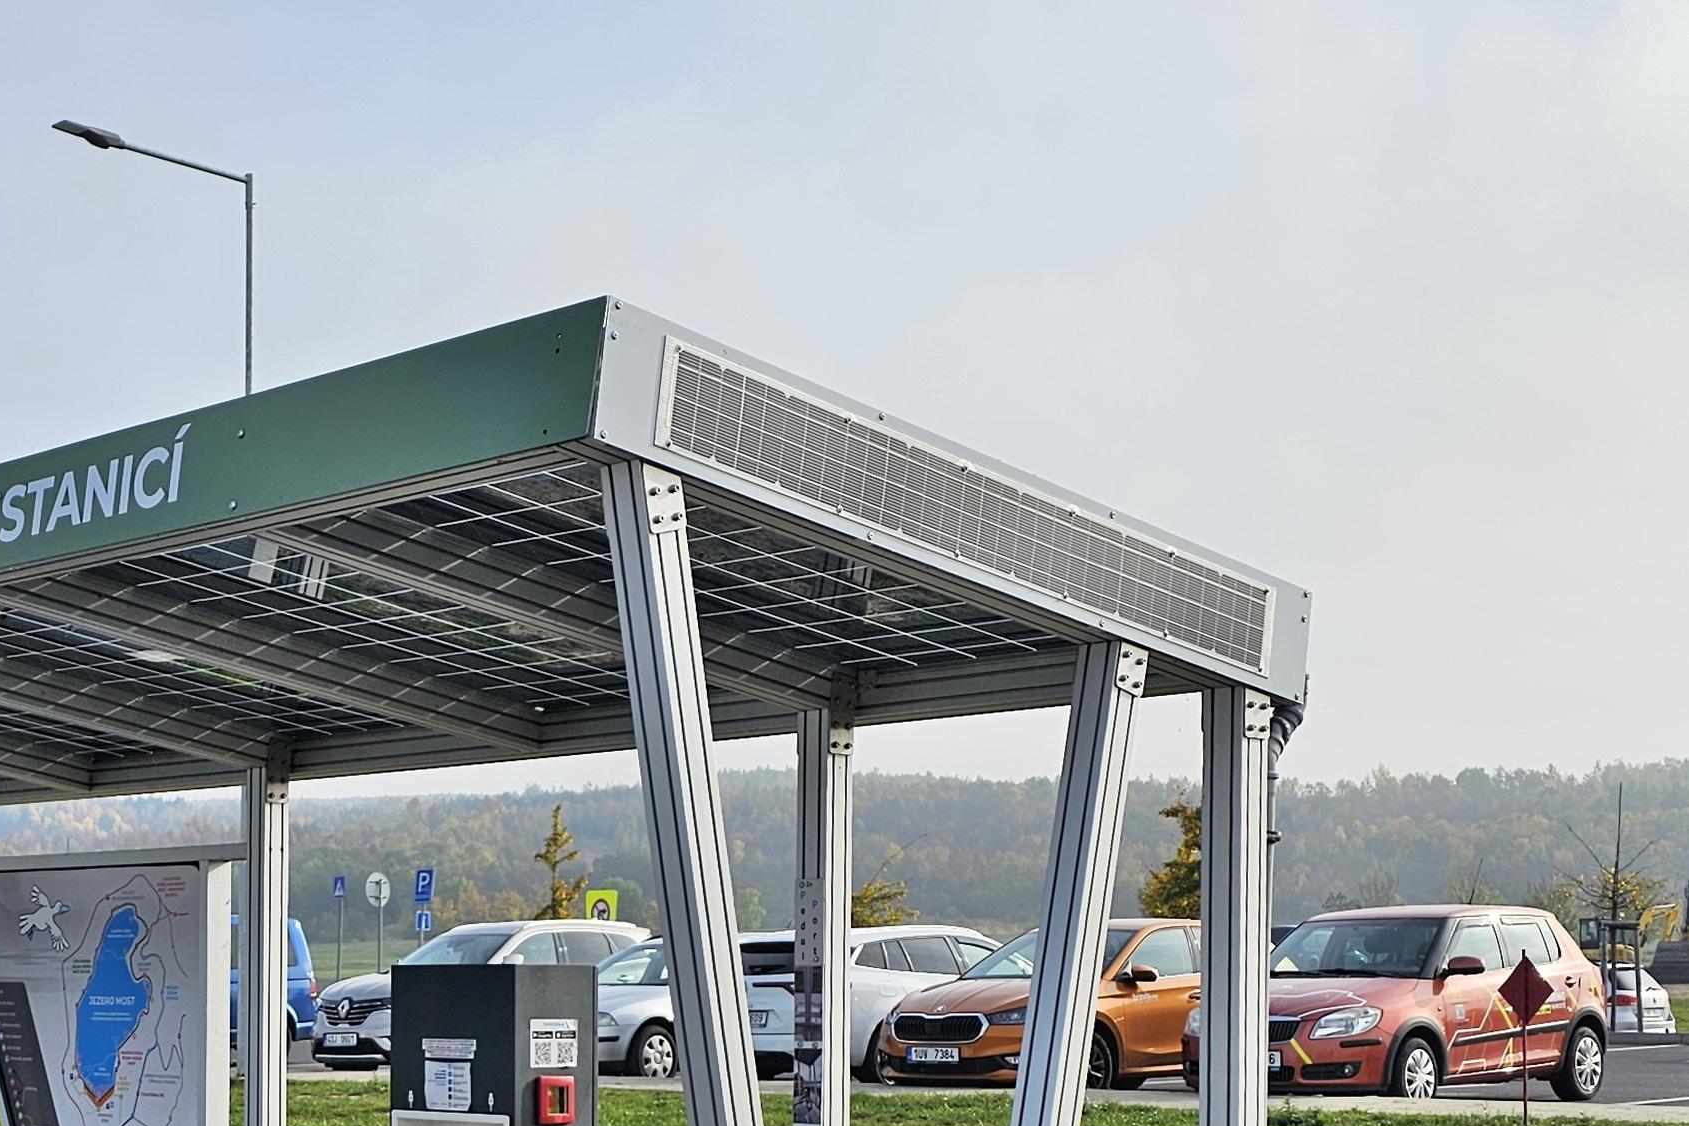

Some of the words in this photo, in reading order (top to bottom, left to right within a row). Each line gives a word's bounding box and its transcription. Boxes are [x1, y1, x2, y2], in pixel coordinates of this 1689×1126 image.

[418, 872, 430, 893] P
[88, 996, 114, 1006] JEZERO
[115, 996, 136, 1006] MOST
[934, 1048, 955, 1060] 7384
